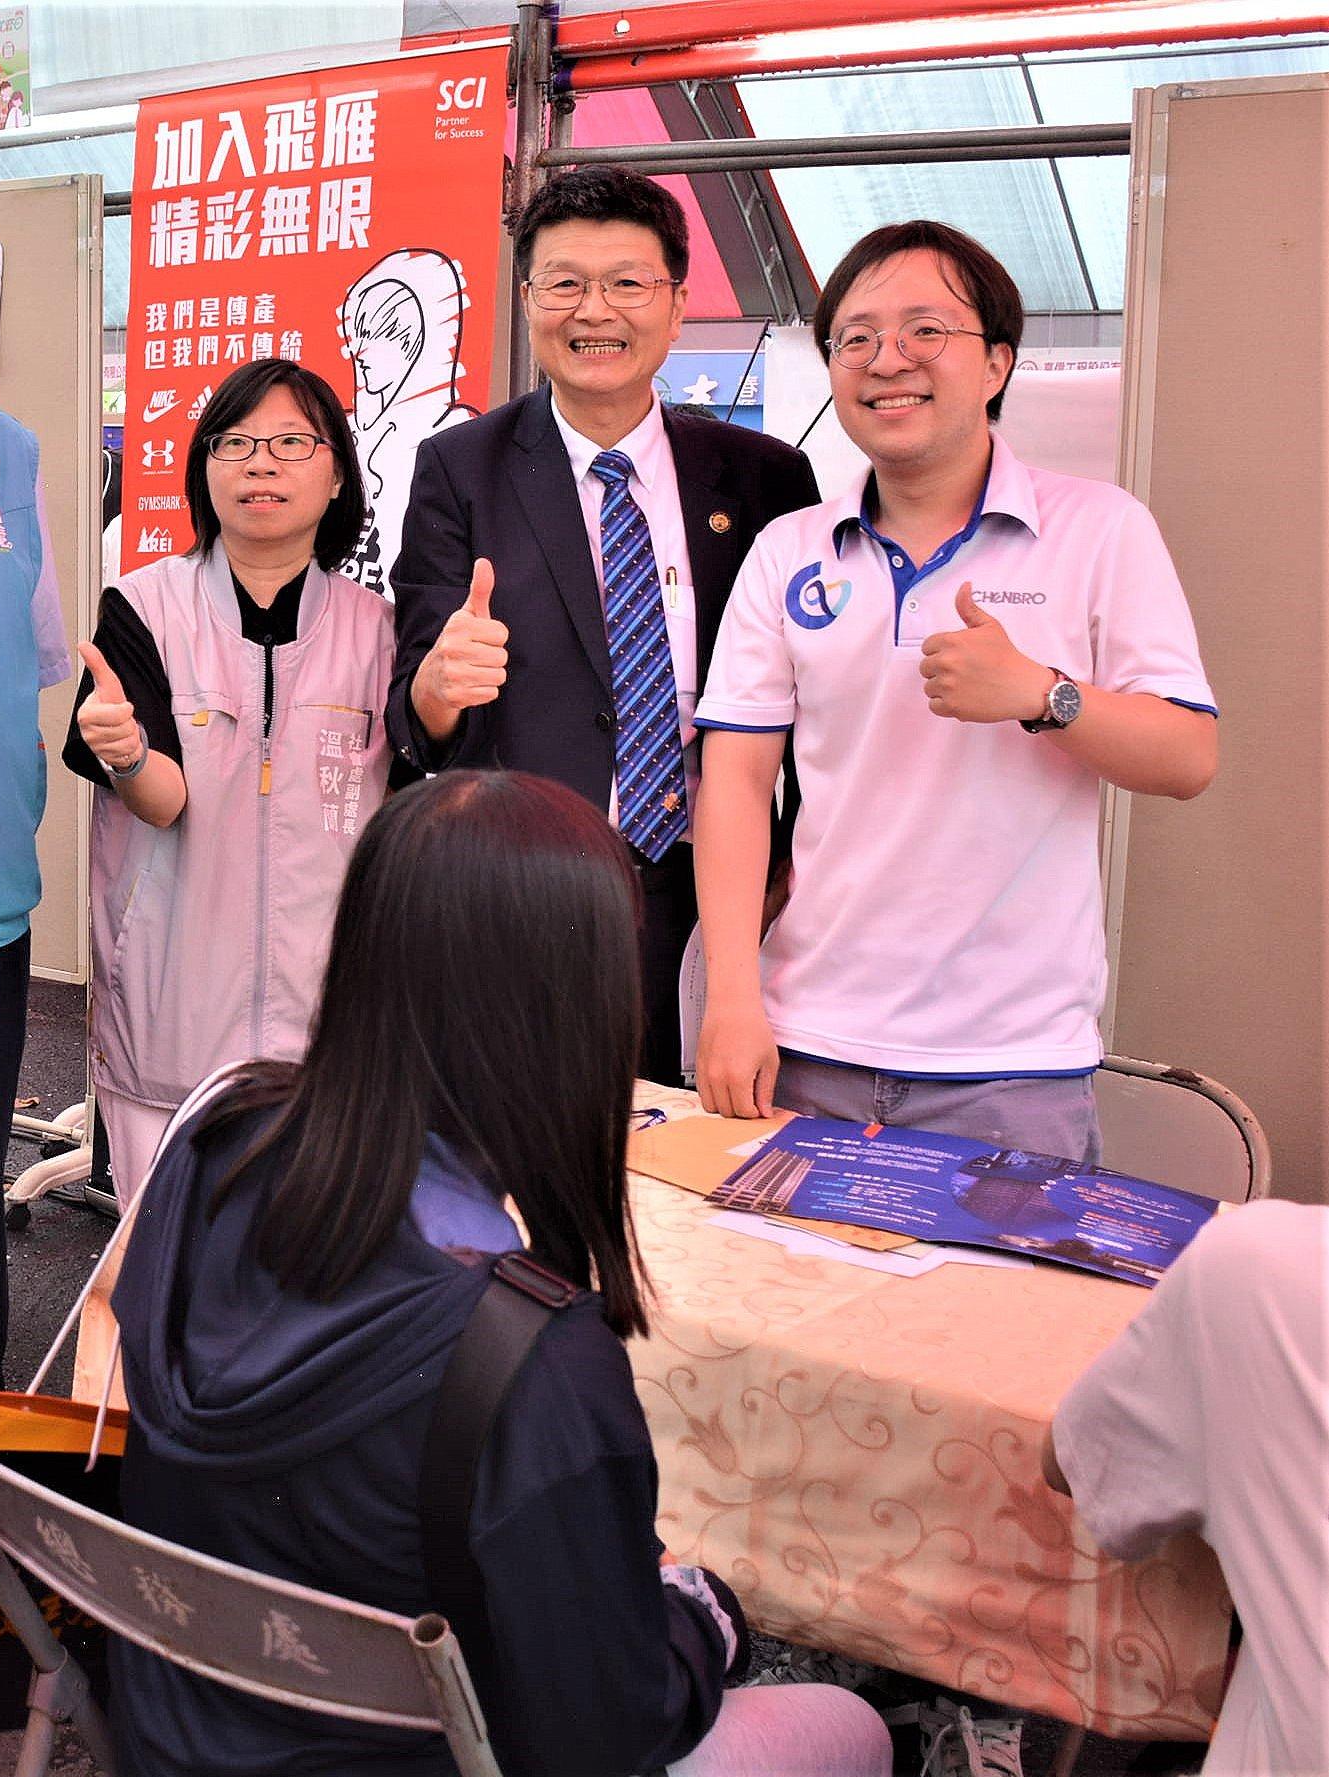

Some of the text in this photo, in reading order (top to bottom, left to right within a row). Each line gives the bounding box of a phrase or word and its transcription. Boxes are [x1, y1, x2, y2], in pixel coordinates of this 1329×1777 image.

[436, 77, 487, 111] SCI
[436, 117, 469, 127] Partner
[152, 90, 379, 190] 加入飛雁
[435, 127, 484, 139] for Success
[149, 177, 372, 268] 精彩無限
[145, 293, 276, 333] 我們是傳產
[144, 330, 304, 370] 但我們不傳統
[150, 389, 176, 408] NIKE
[138, 497, 181, 511] GYMSHARK
[149, 538, 172, 553] REI
[972, 591, 1047, 605] CHENBRO
